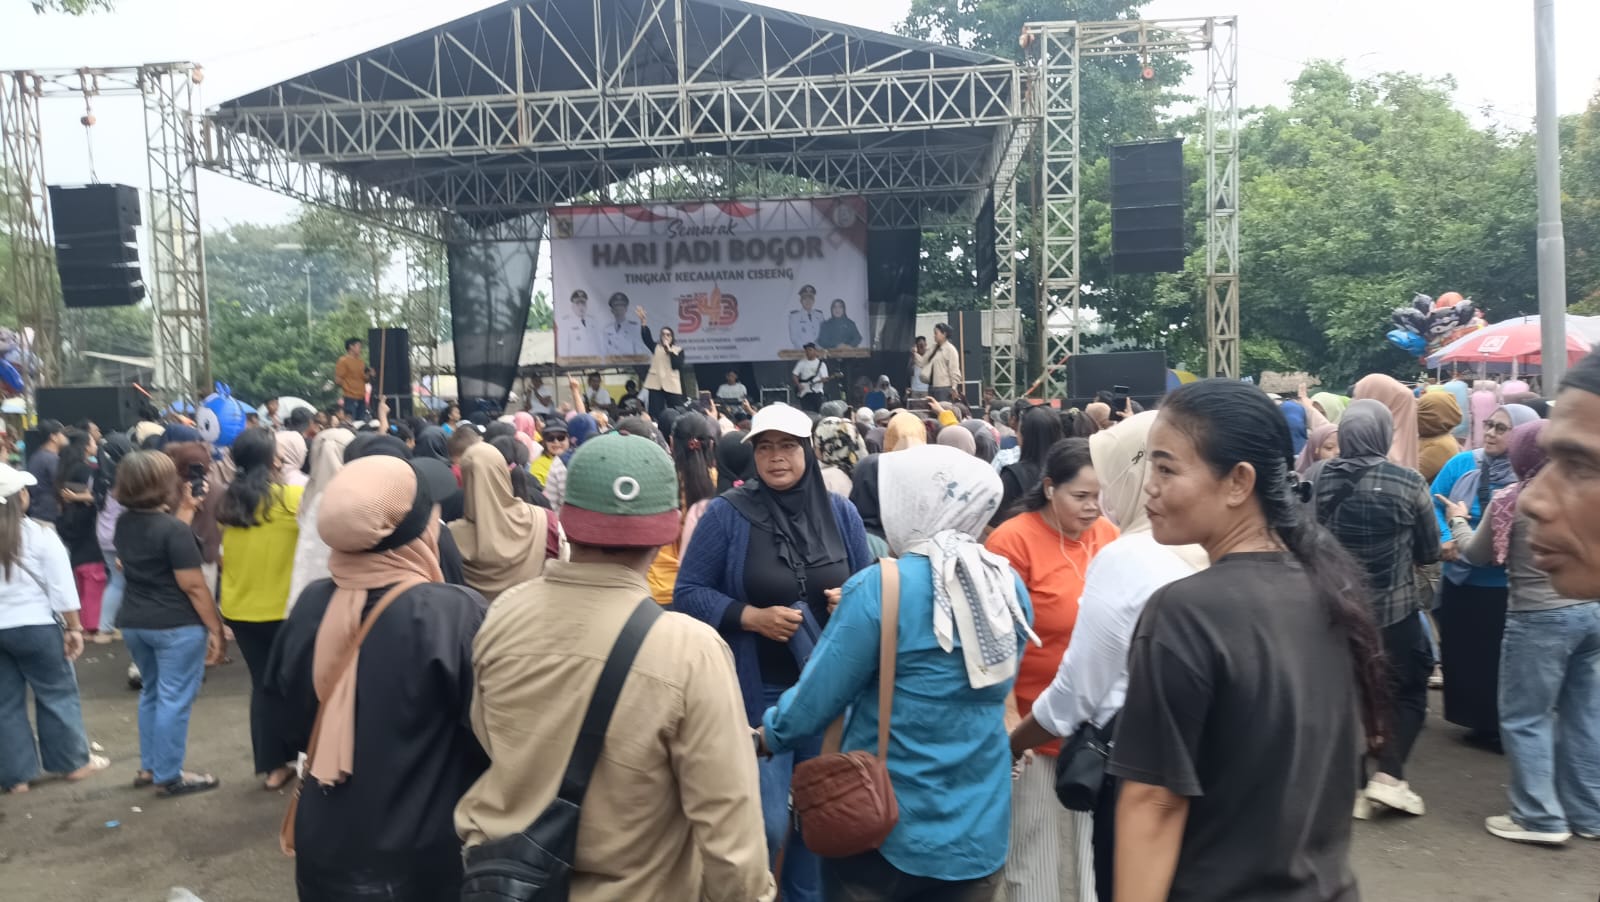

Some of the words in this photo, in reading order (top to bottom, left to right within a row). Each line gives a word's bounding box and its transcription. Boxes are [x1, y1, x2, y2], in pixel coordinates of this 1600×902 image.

[667, 218, 737, 239] Semarak
[592, 243, 657, 267] HARI
[663, 239, 720, 268] JADI
[728, 236, 824, 265] BOGOR
[624, 272, 671, 285] TINGKAT
[675, 270, 743, 283] KECAMATAN
[747, 268, 793, 280] CISEENG
